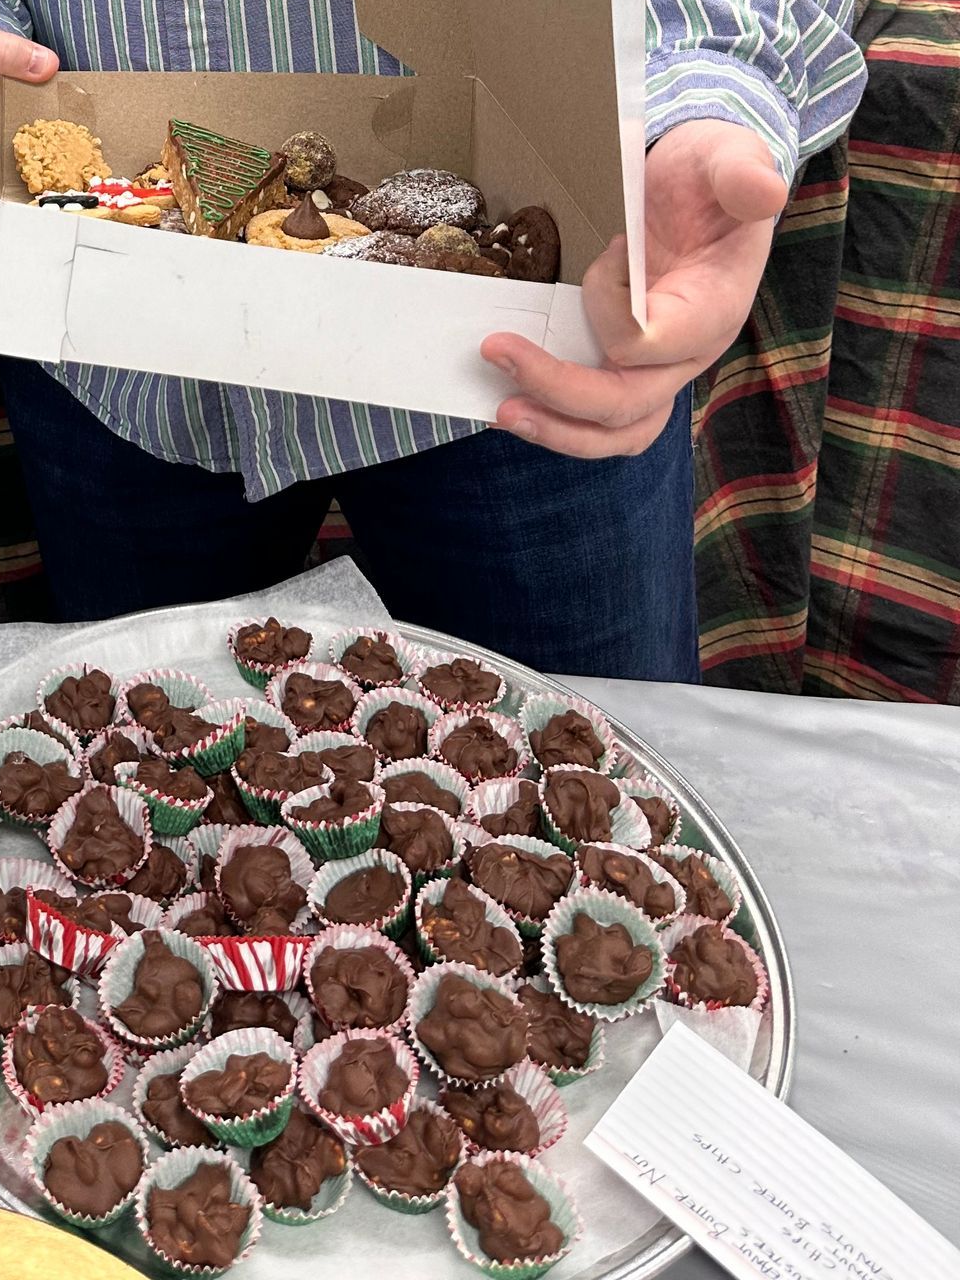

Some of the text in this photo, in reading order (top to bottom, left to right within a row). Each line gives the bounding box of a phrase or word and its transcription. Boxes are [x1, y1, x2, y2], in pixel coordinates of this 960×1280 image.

[692, 1133, 741, 1174] CHIPS
[623, 1152, 780, 1280] EANUT BUTTER NUT
[753, 1180, 810, 1230] BUTTER
[741, 1227, 801, 1280] USTERS
